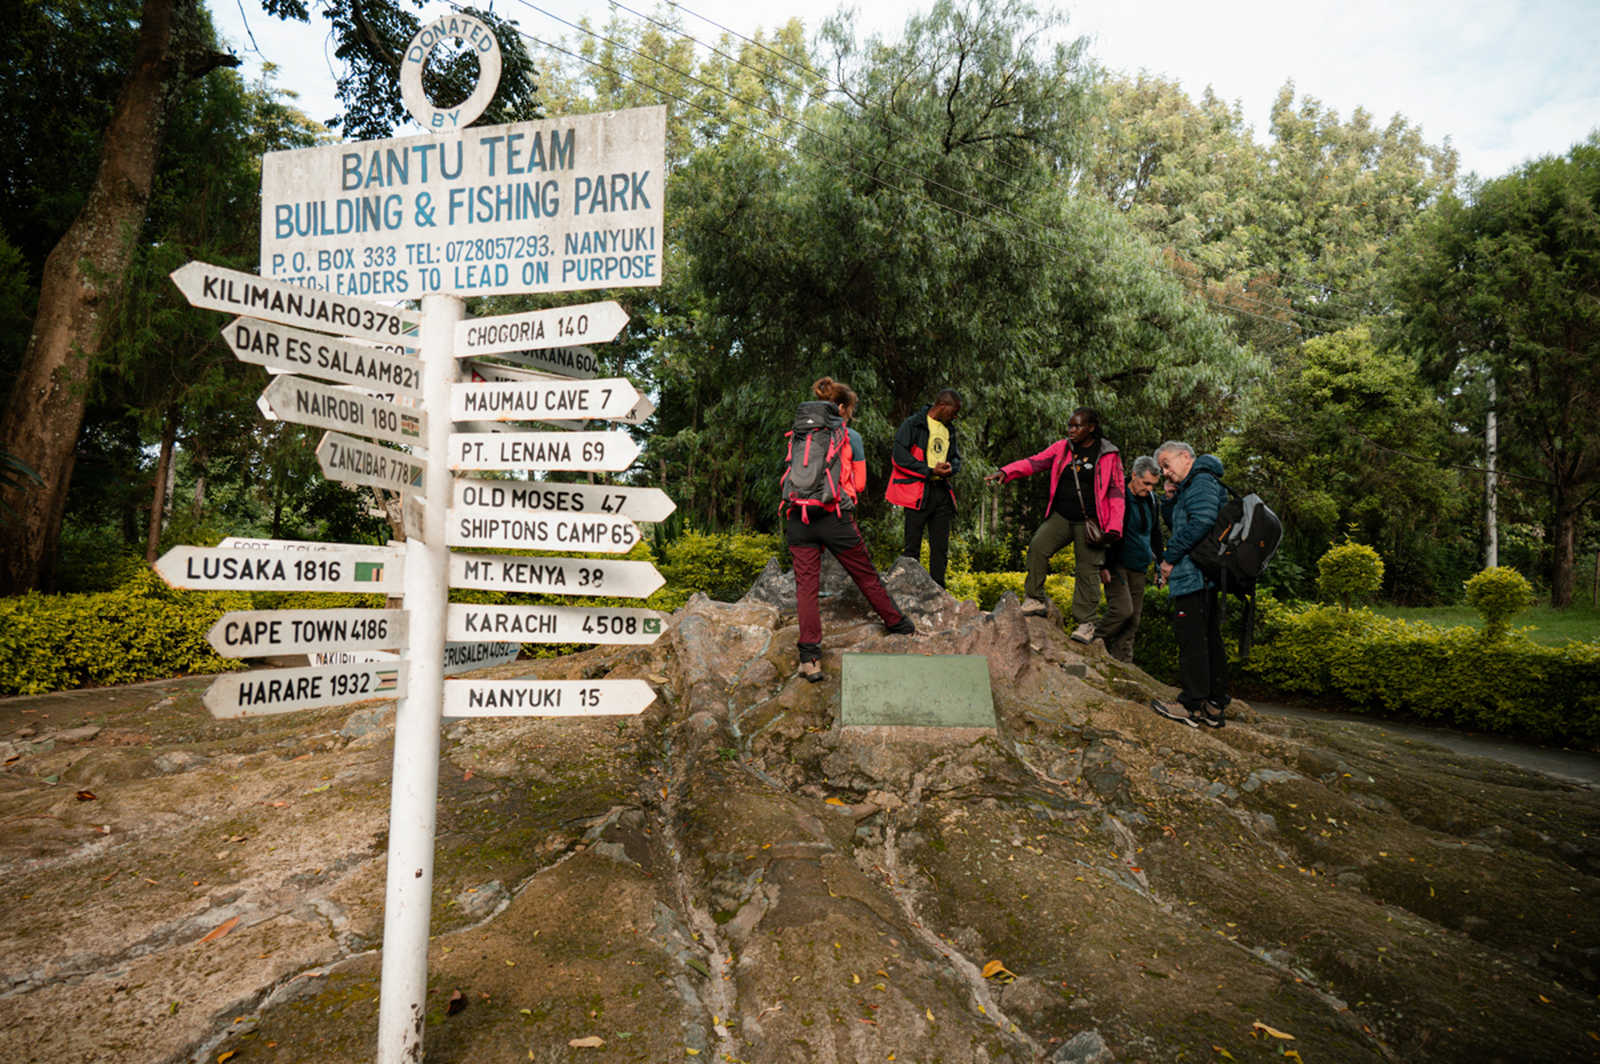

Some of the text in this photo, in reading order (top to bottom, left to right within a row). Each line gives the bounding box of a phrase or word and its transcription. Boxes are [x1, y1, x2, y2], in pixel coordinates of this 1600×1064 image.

[408, 18, 492, 63] DONATED
[432, 110, 460, 127] BY
[341, 128, 575, 191] BANTU TEAM
[275, 171, 651, 239] BUILDING & FISHING PARK
[318, 249, 355, 271] BOX
[363, 247, 396, 267] 333
[406, 243, 440, 264] TEL:
[564, 227, 655, 256] NANYUKI
[418, 267, 442, 291] TO
[455, 263, 509, 289] LEAD
[522, 261, 549, 284] ON
[562, 255, 657, 283] PURPOSE
[467, 314, 589, 347] CHOGORIA 140
[236, 325, 280, 357] DAR
[286, 338, 312, 364] ES
[576, 354, 599, 373] 604
[296, 390, 398, 432] NAIROBI 180
[464, 389, 613, 412] MAUMAU CAVE 7
[329, 443, 409, 485] ZANZIBAR 778
[461, 442, 488, 462] PT.
[500, 442, 572, 462] LENANA
[463, 487, 627, 513] OLD MOSES 47
[460, 519, 549, 542] SHIPTONS
[186, 556, 341, 582] LUSAKA 1816
[464, 561, 604, 588] MT. KENYA 38
[224, 621, 282, 645] CAPE
[465, 613, 637, 635] KARACHI 4508
[238, 673, 370, 706] HARARE 1932
[469, 688, 600, 708] NANYUKI 15
